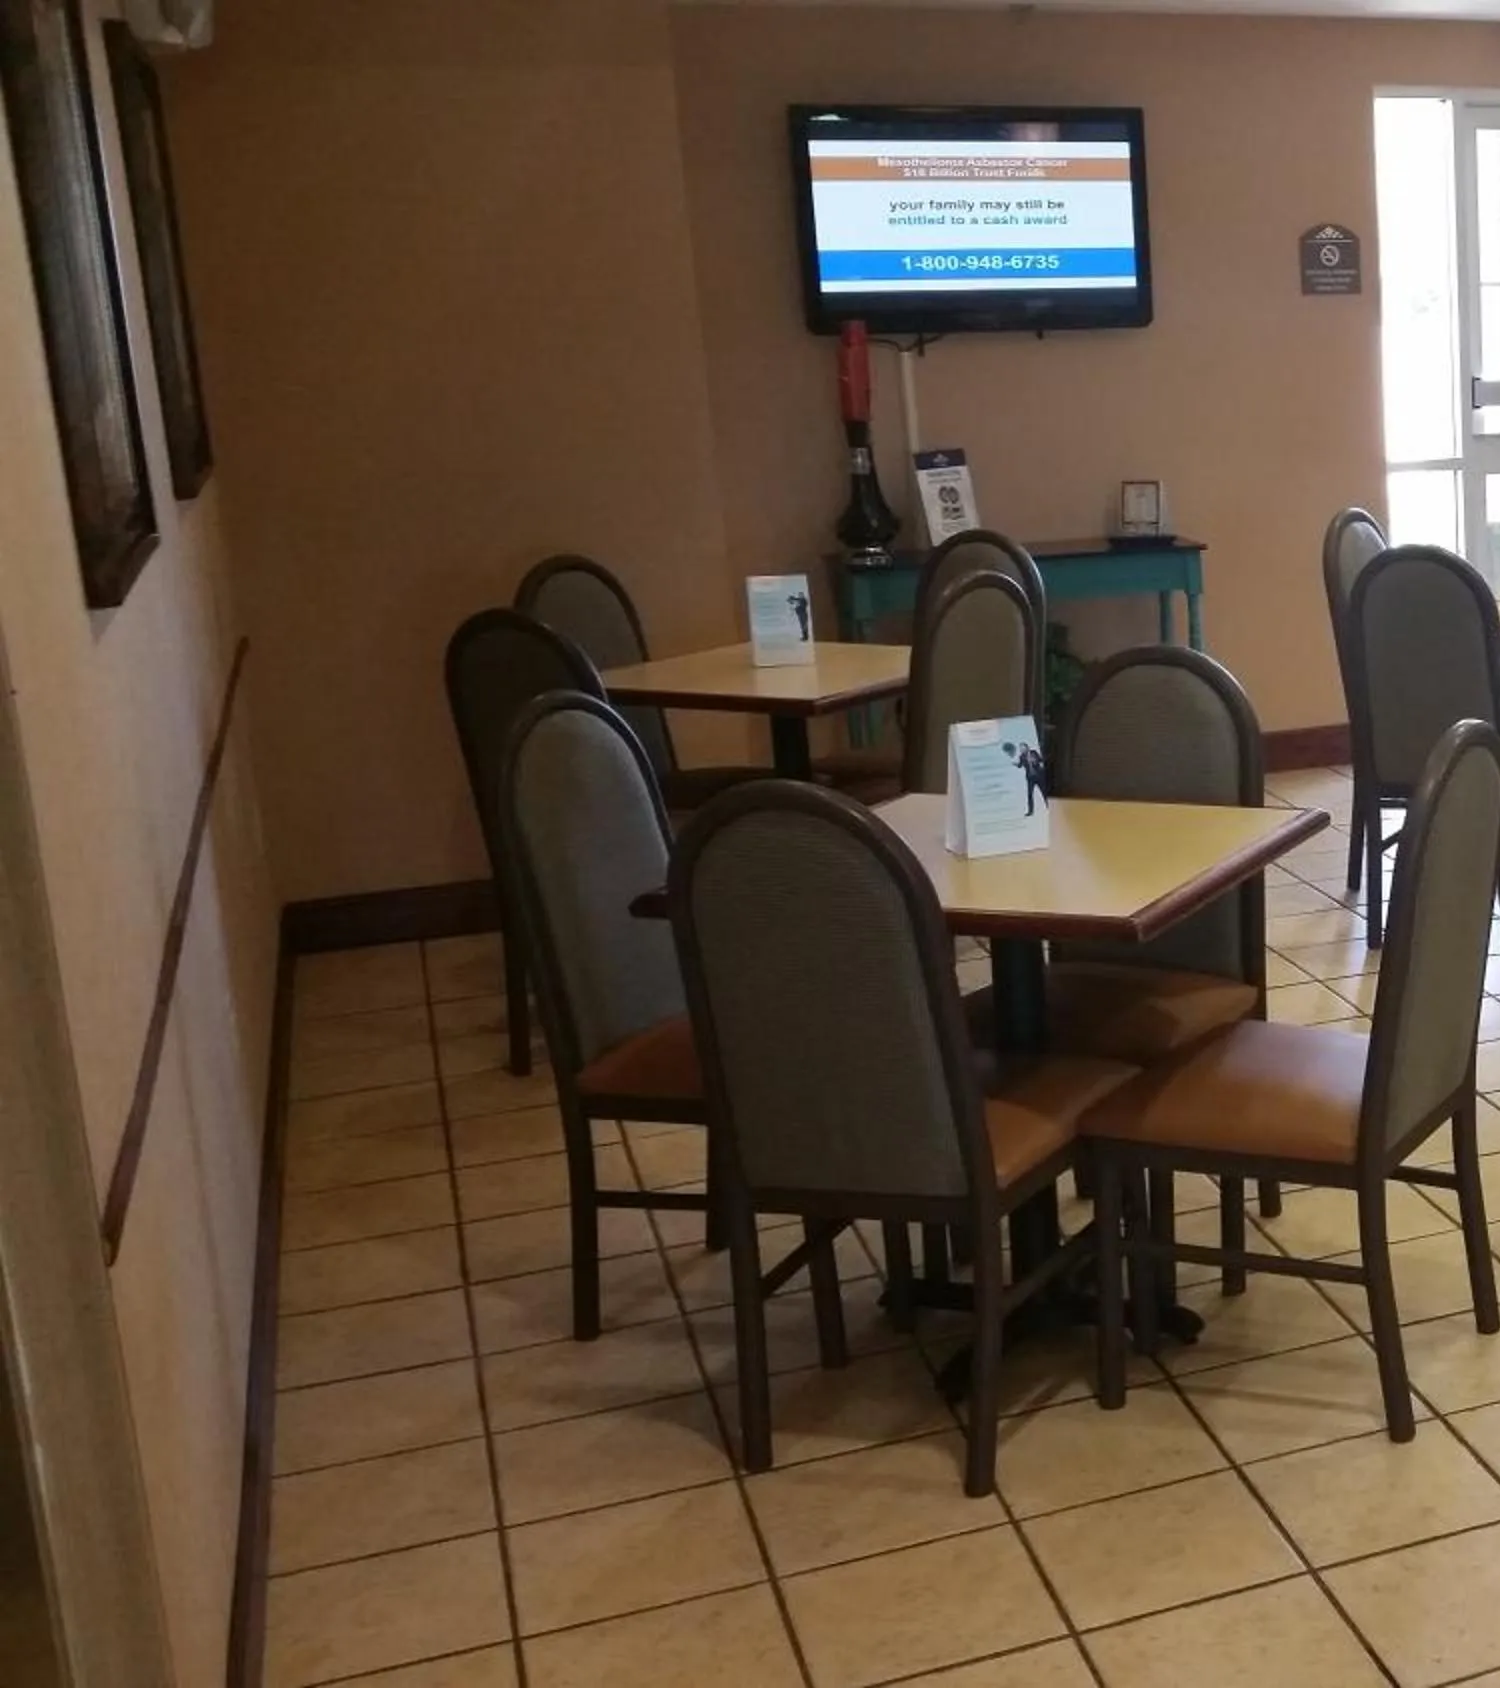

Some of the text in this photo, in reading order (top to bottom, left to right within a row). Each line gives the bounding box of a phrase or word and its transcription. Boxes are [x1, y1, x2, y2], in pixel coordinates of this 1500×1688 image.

[973, 167, 1004, 177] Trust
[889, 199, 1065, 213] your family may still be
[888, 214, 1067, 225] entitled to a cash award
[901, 254, 1060, 272] 1-800-948-6735
